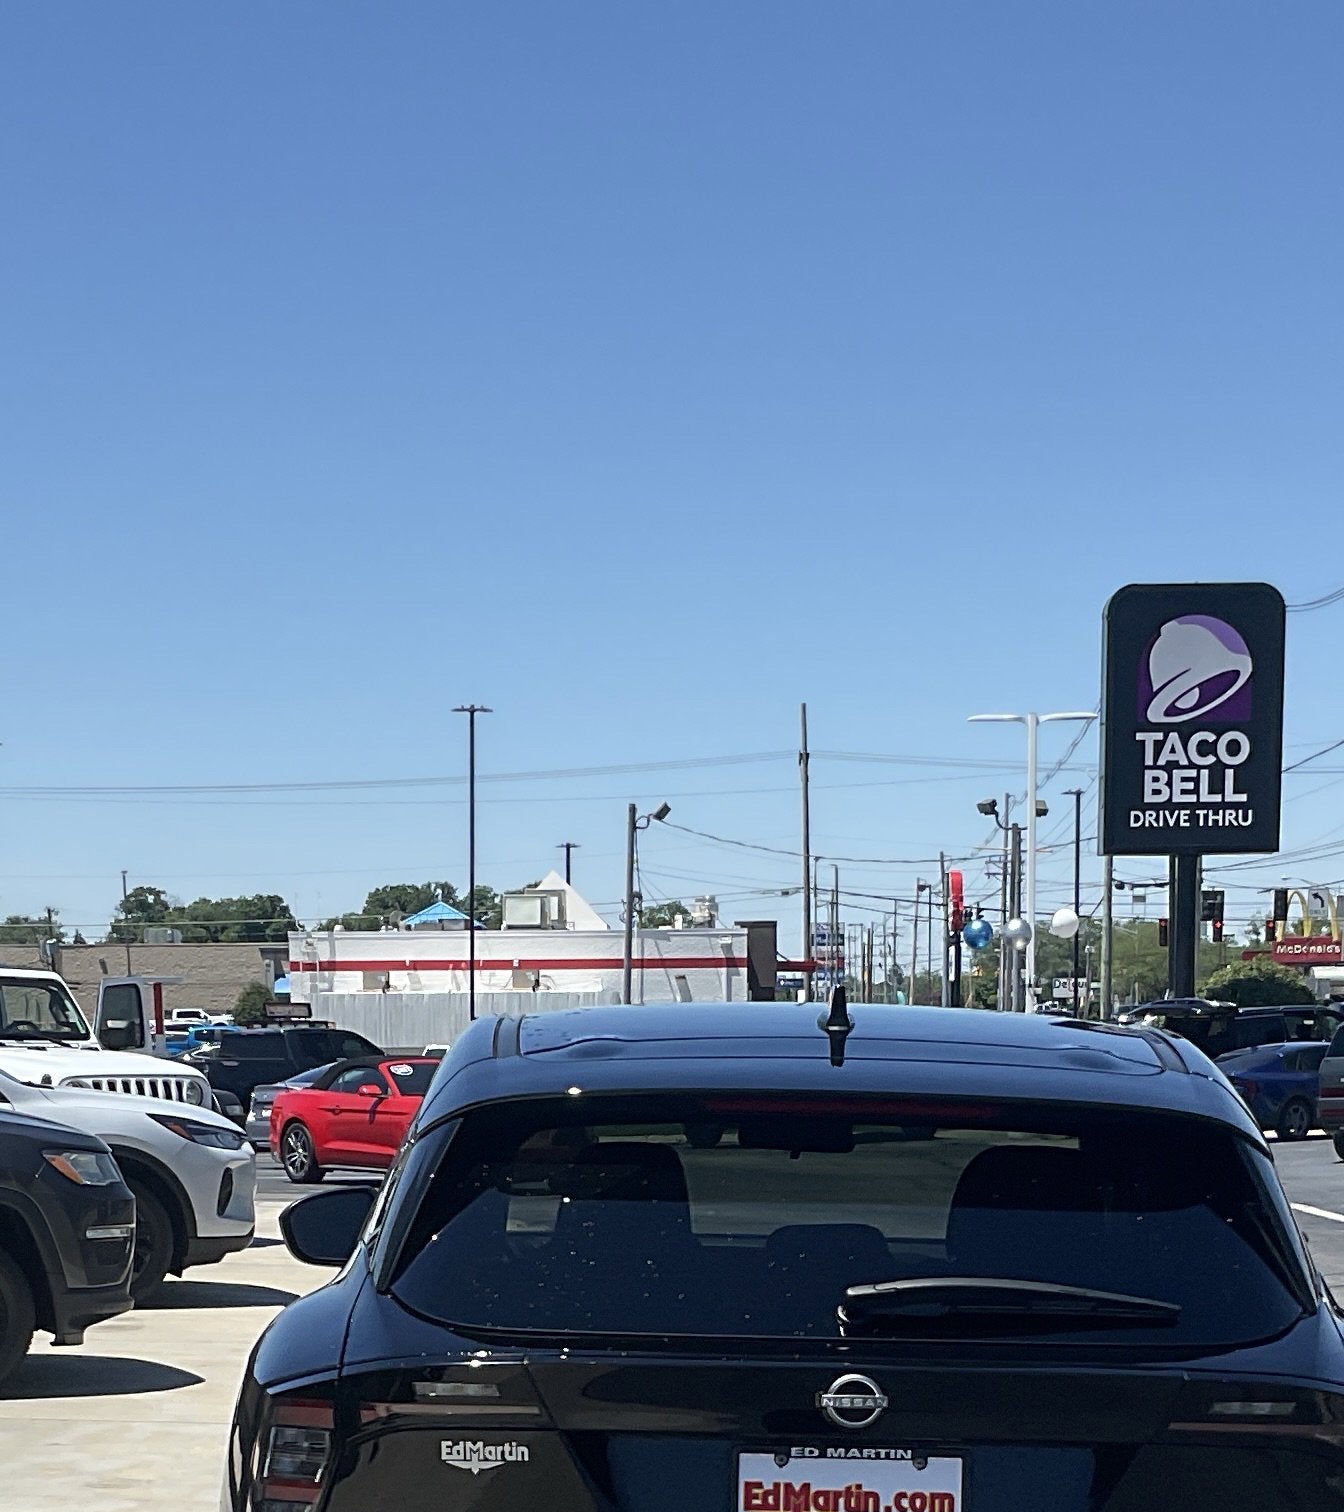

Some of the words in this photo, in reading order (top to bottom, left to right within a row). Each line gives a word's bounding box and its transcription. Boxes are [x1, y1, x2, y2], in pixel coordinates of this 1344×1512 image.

[1136, 731, 1250, 766] TACO
[1144, 769, 1248, 803] BELL
[1130, 810, 1190, 828] DRIVE
[1196, 809, 1253, 827] THRU
[1276, 944, 1341, 955] McDonald's
[822, 1398, 887, 1407] NISSAN
[441, 1441, 529, 1474] EdMartin
[791, 1447, 818, 1457] ED
[827, 1448, 912, 1459] MARTIN
